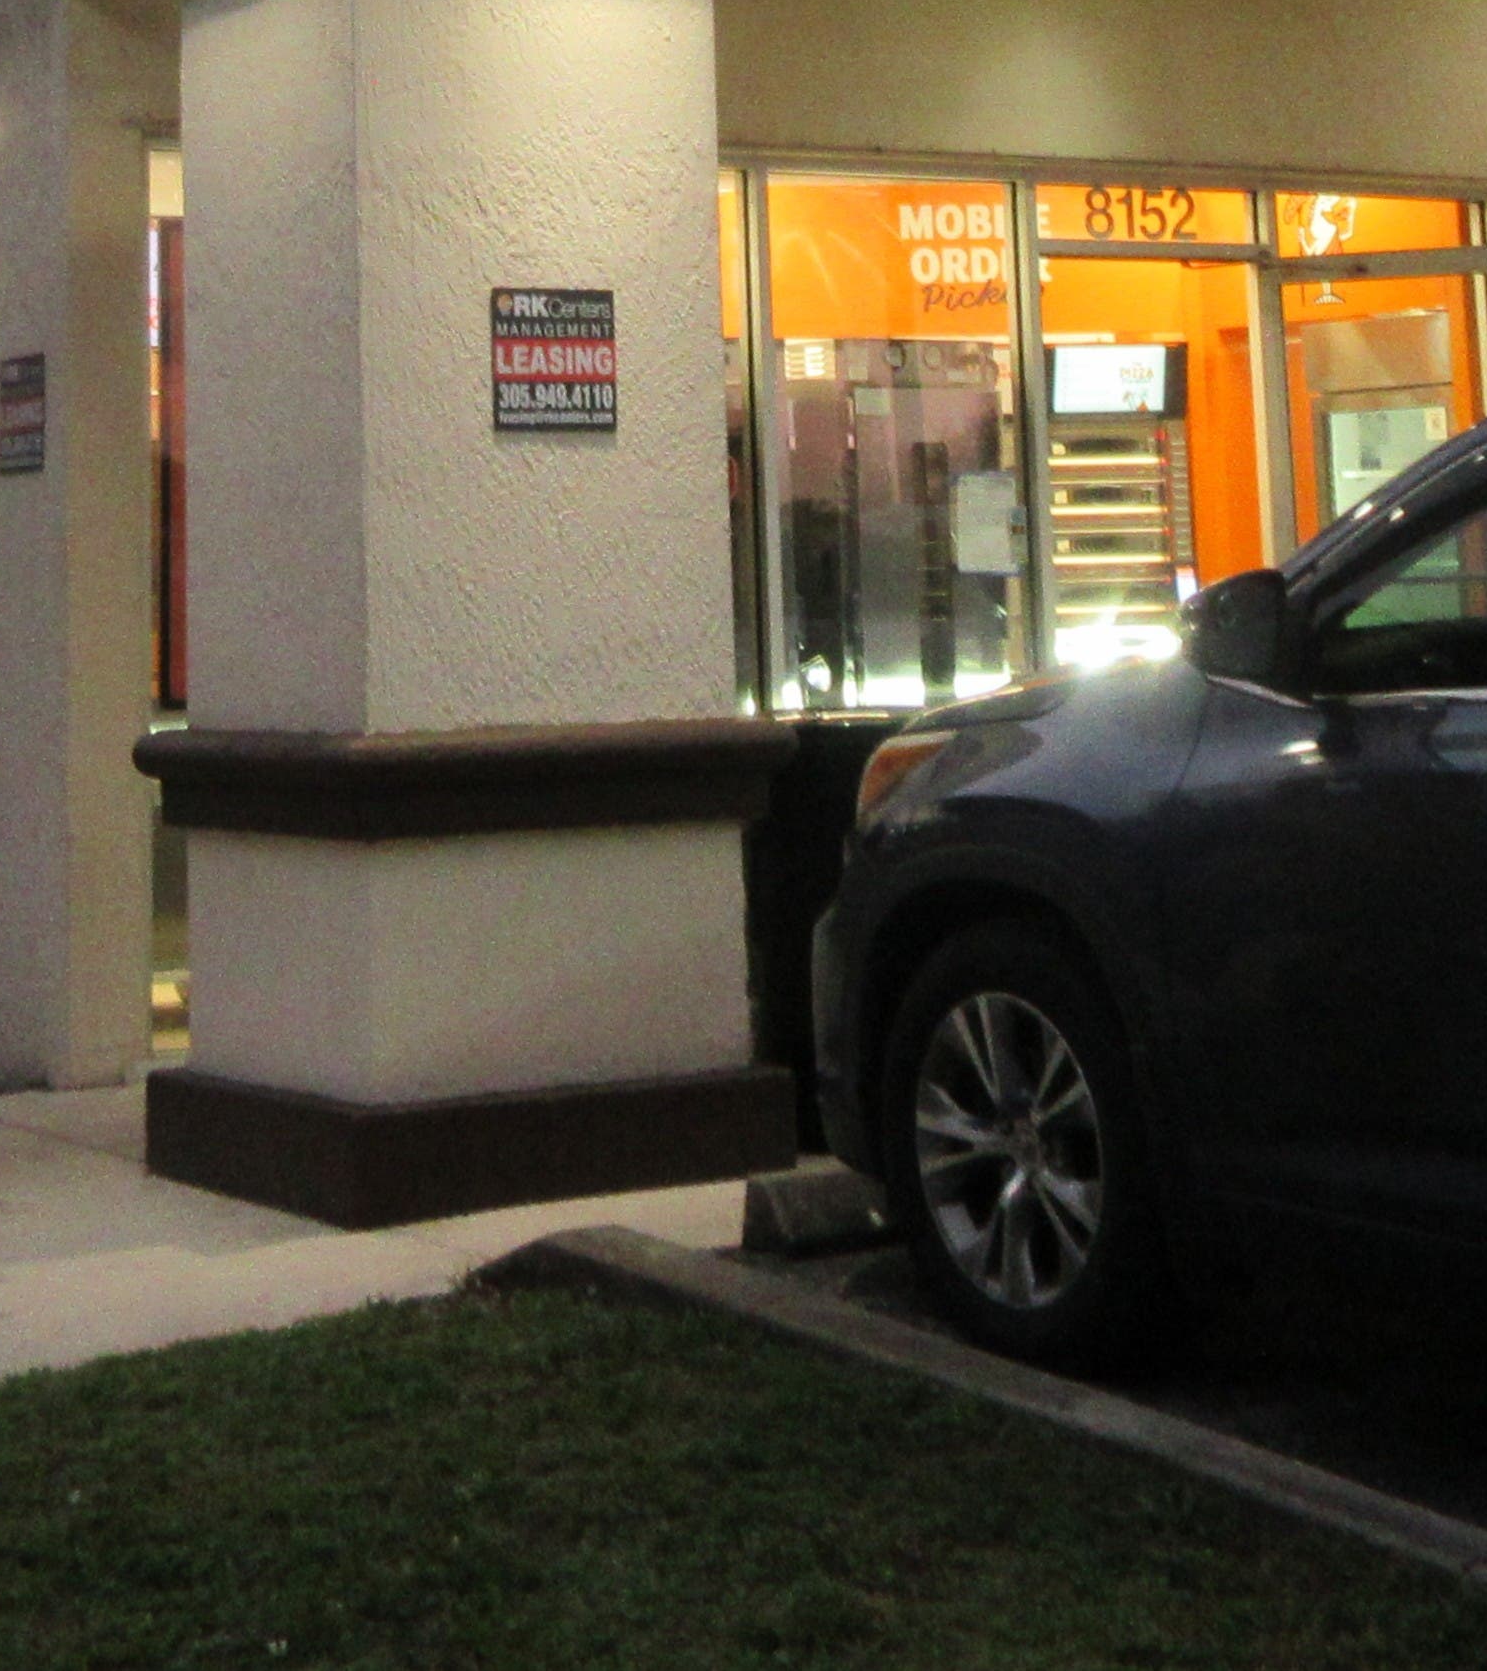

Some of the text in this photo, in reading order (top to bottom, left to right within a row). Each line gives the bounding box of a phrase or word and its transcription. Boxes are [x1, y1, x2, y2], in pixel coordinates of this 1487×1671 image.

[899, 203, 1052, 241] MOBIE
[1085, 186, 1197, 241] 8152
[513, 293, 611, 319] RK Centers
[495, 320, 612, 338] MANAGEMENT
[496, 344, 613, 376] LEASING
[498, 382, 614, 409] 305.949.4110
